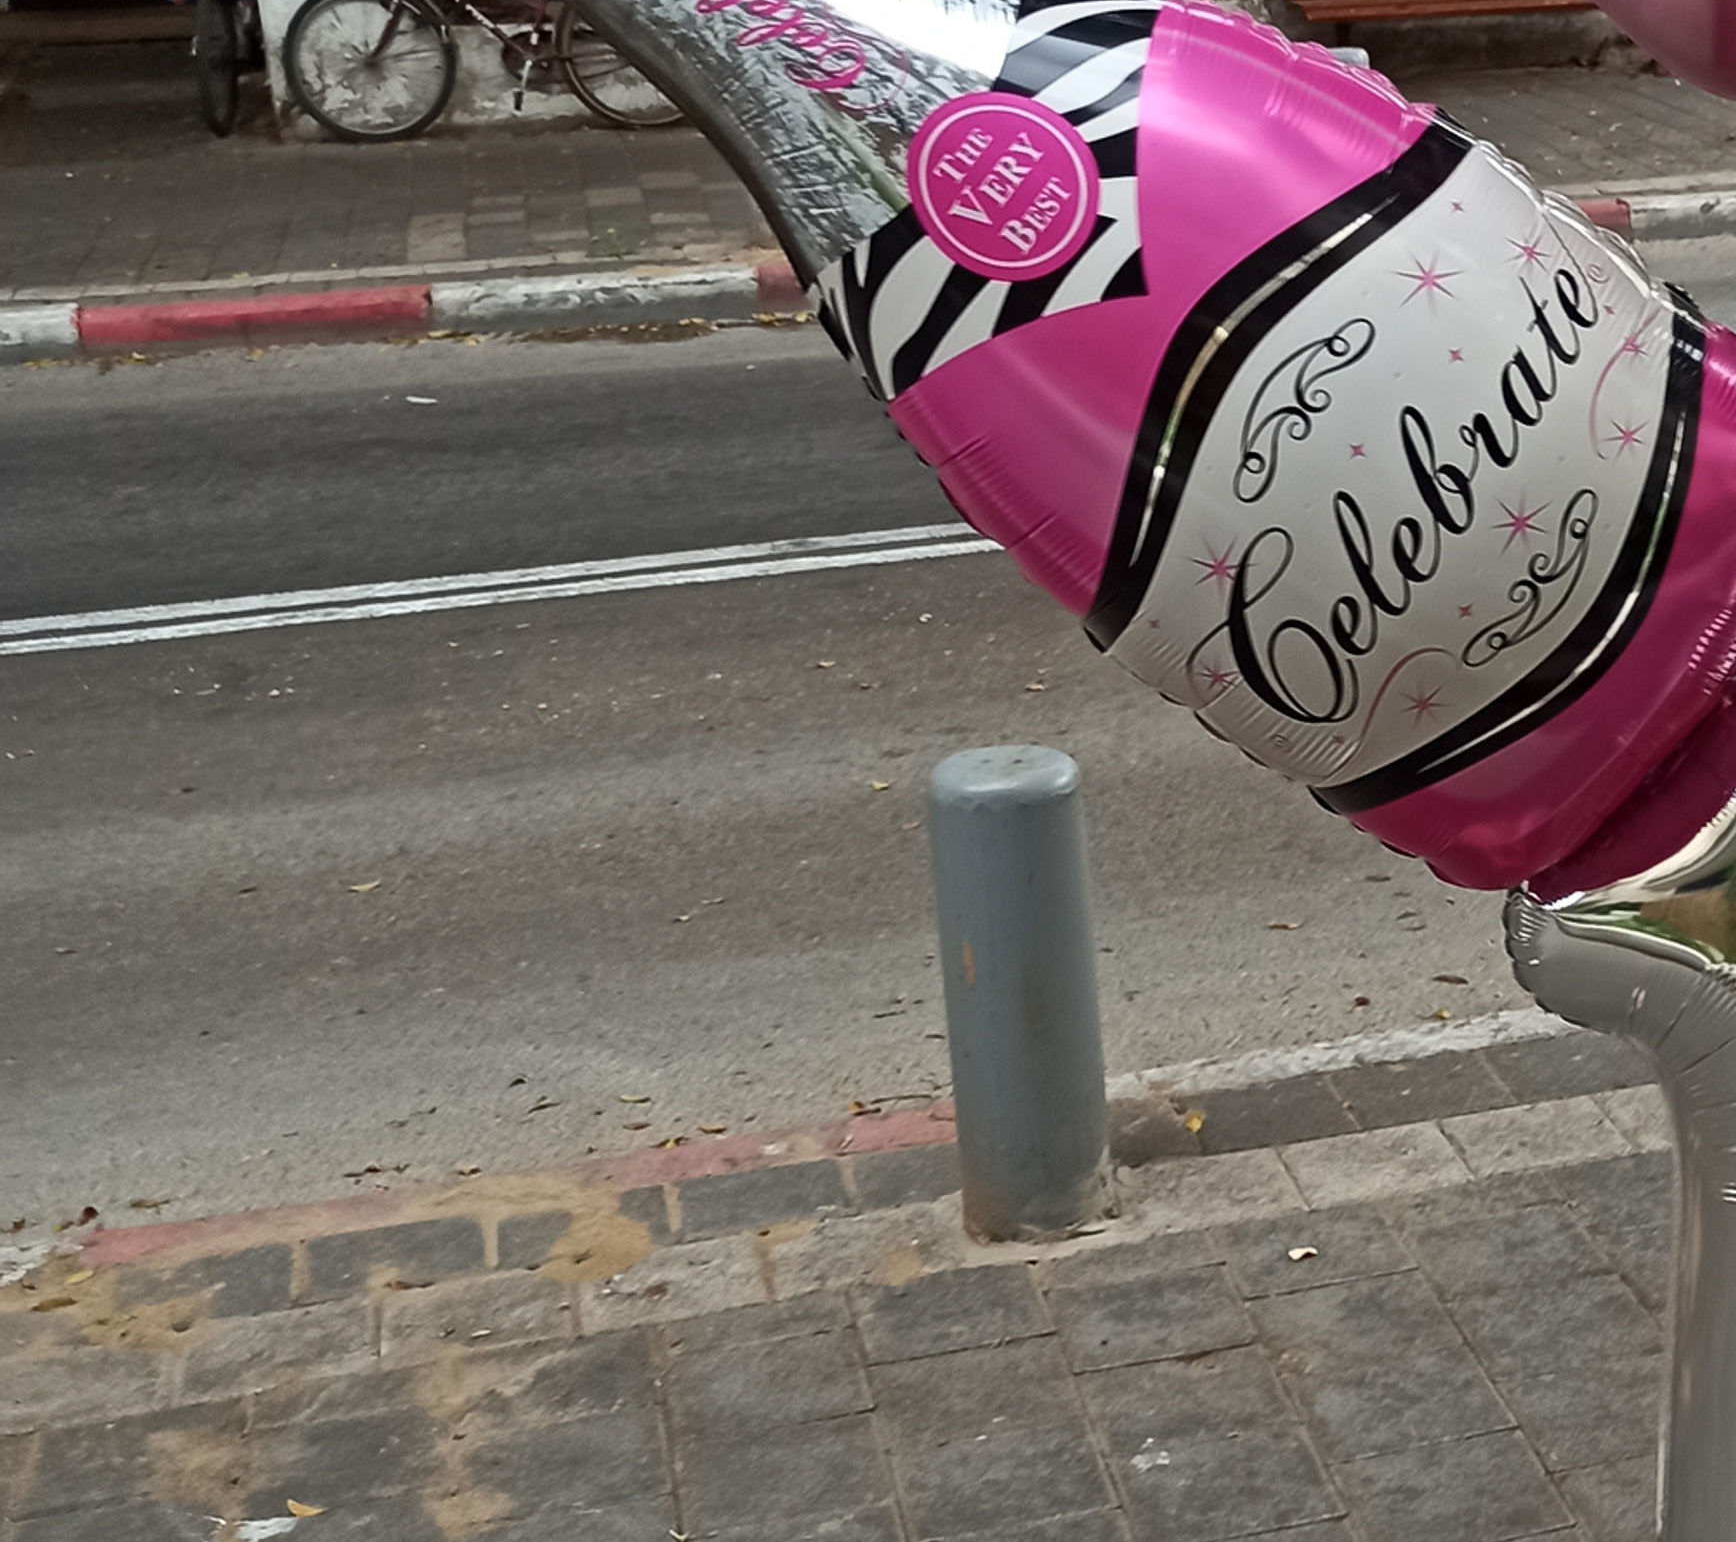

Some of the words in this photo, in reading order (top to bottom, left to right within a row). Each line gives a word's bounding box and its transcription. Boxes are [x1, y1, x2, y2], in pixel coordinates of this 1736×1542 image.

[932, 127, 994, 184] THE
[946, 131, 1044, 226] VERY
[998, 176, 1072, 255] BEST
[1188, 265, 1600, 723] Celebrate
